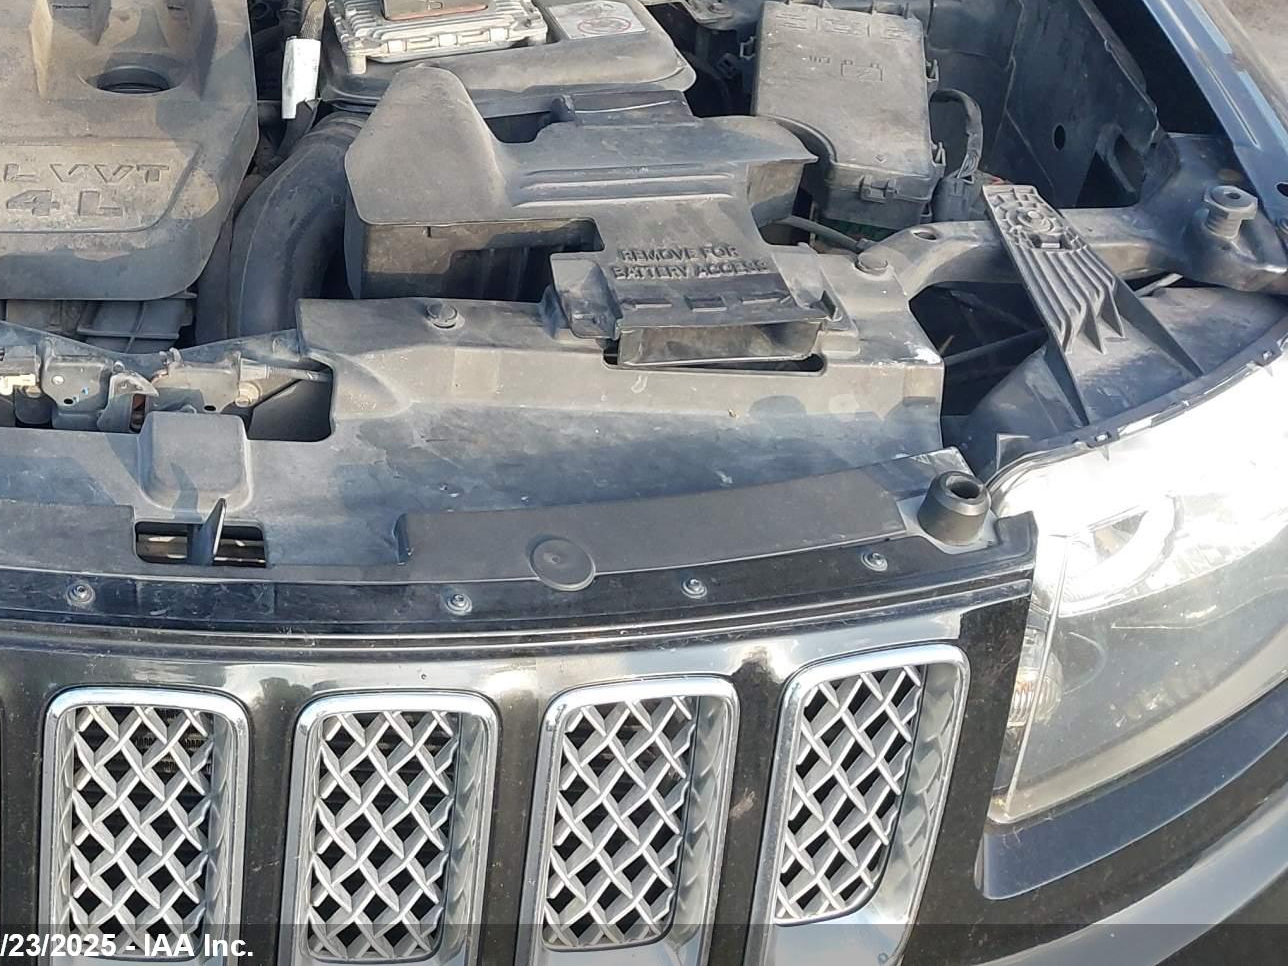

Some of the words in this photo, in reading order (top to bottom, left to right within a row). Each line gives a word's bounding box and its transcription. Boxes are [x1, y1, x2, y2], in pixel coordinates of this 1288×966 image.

[48, 162, 171, 184] VVT
[617, 247, 696, 263] REMOVE
[699, 245, 740, 260] FOR
[611, 263, 689, 280] BATTERY
[693, 259, 769, 278] ACCESS
